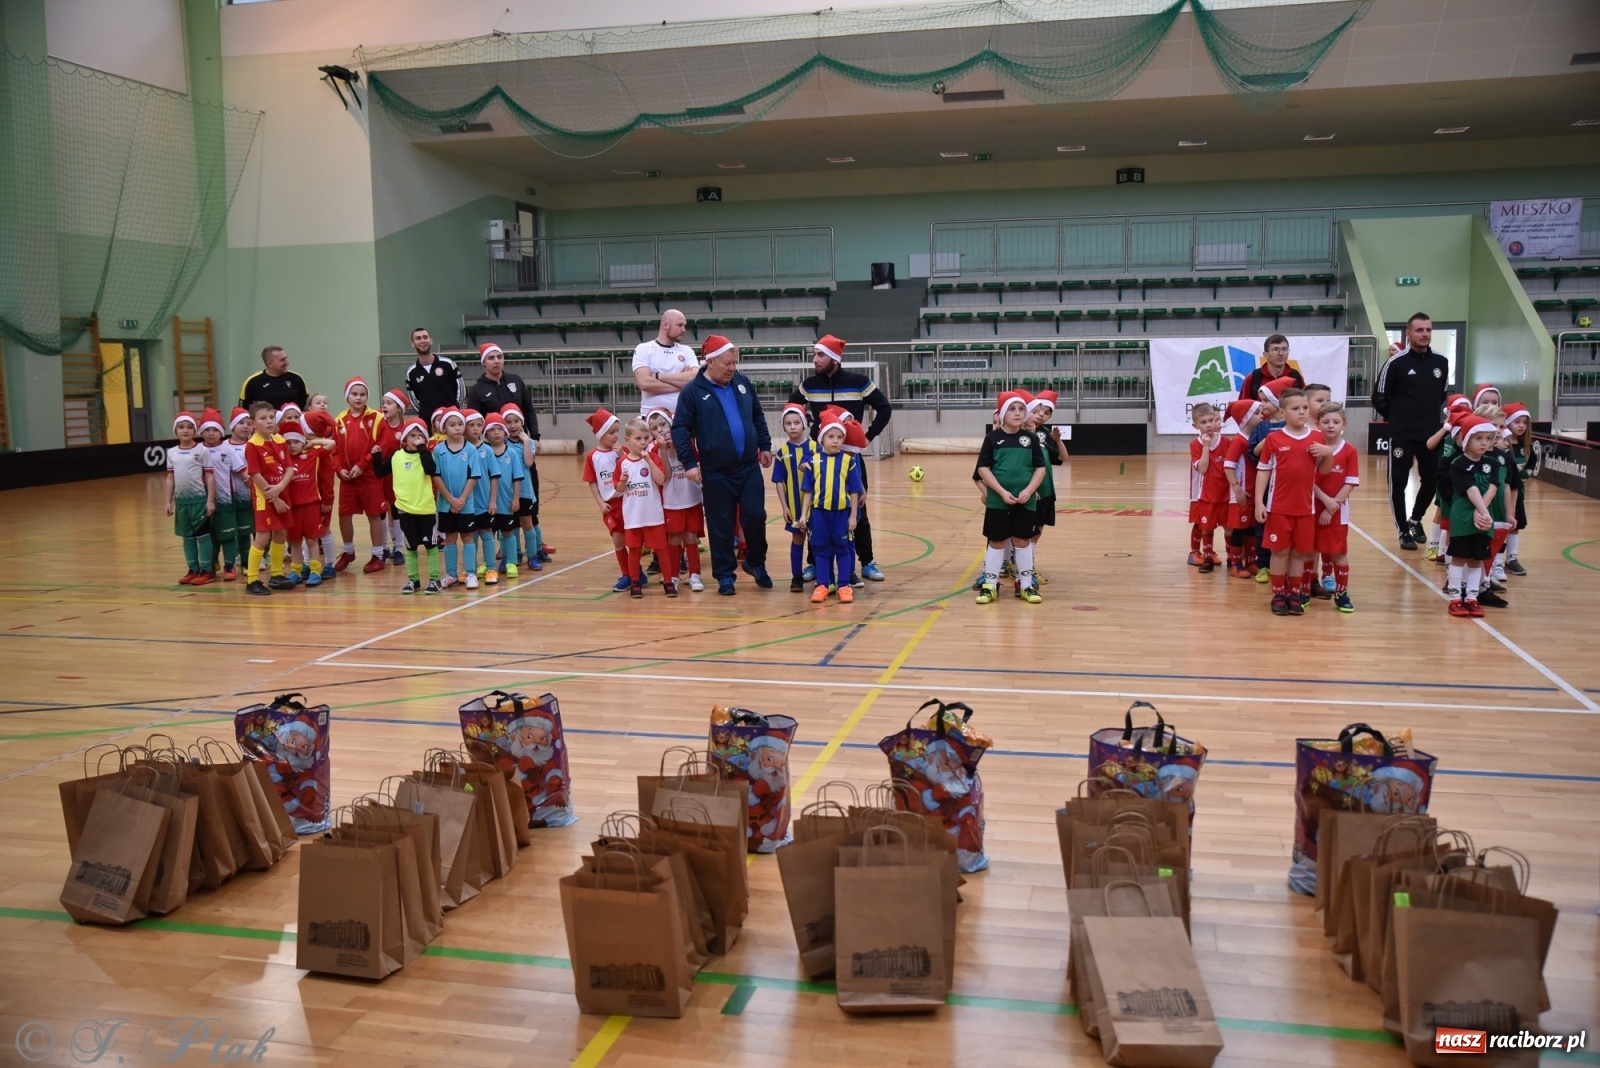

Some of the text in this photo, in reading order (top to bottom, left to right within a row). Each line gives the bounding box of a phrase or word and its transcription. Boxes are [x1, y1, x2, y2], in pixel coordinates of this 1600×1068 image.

[1119, 173, 1128, 182] B
[1133, 172, 1142, 181] B
[708, 191, 719, 200] A
[1500, 202, 1572, 217] MIESZKO
